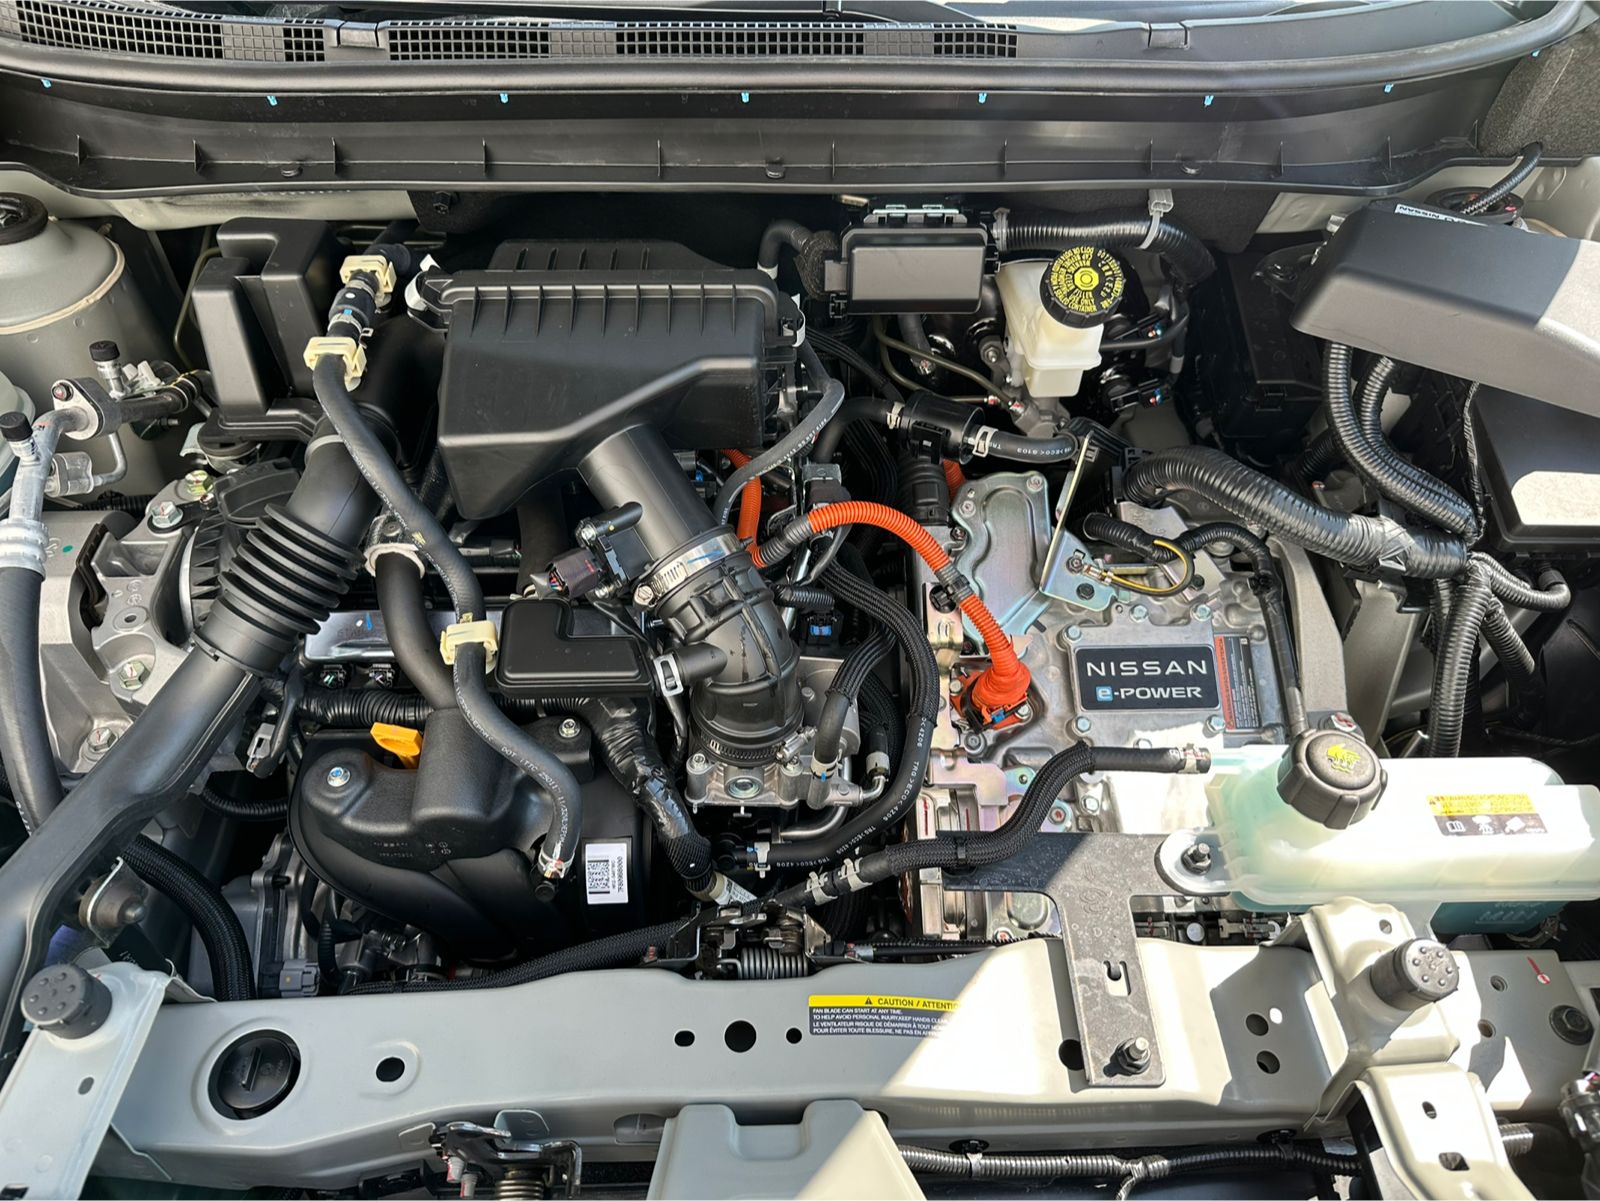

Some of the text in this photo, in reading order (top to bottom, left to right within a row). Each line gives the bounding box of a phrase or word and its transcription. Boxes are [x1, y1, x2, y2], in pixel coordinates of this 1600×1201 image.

[1086, 660, 1207, 676] NISSAN
[1097, 686, 1202, 700] e-POWER
[501, 746, 517, 759] DOT
[878, 998, 914, 1007] CAUTION
[922, 1001, 959, 1010] ATTENTIO
